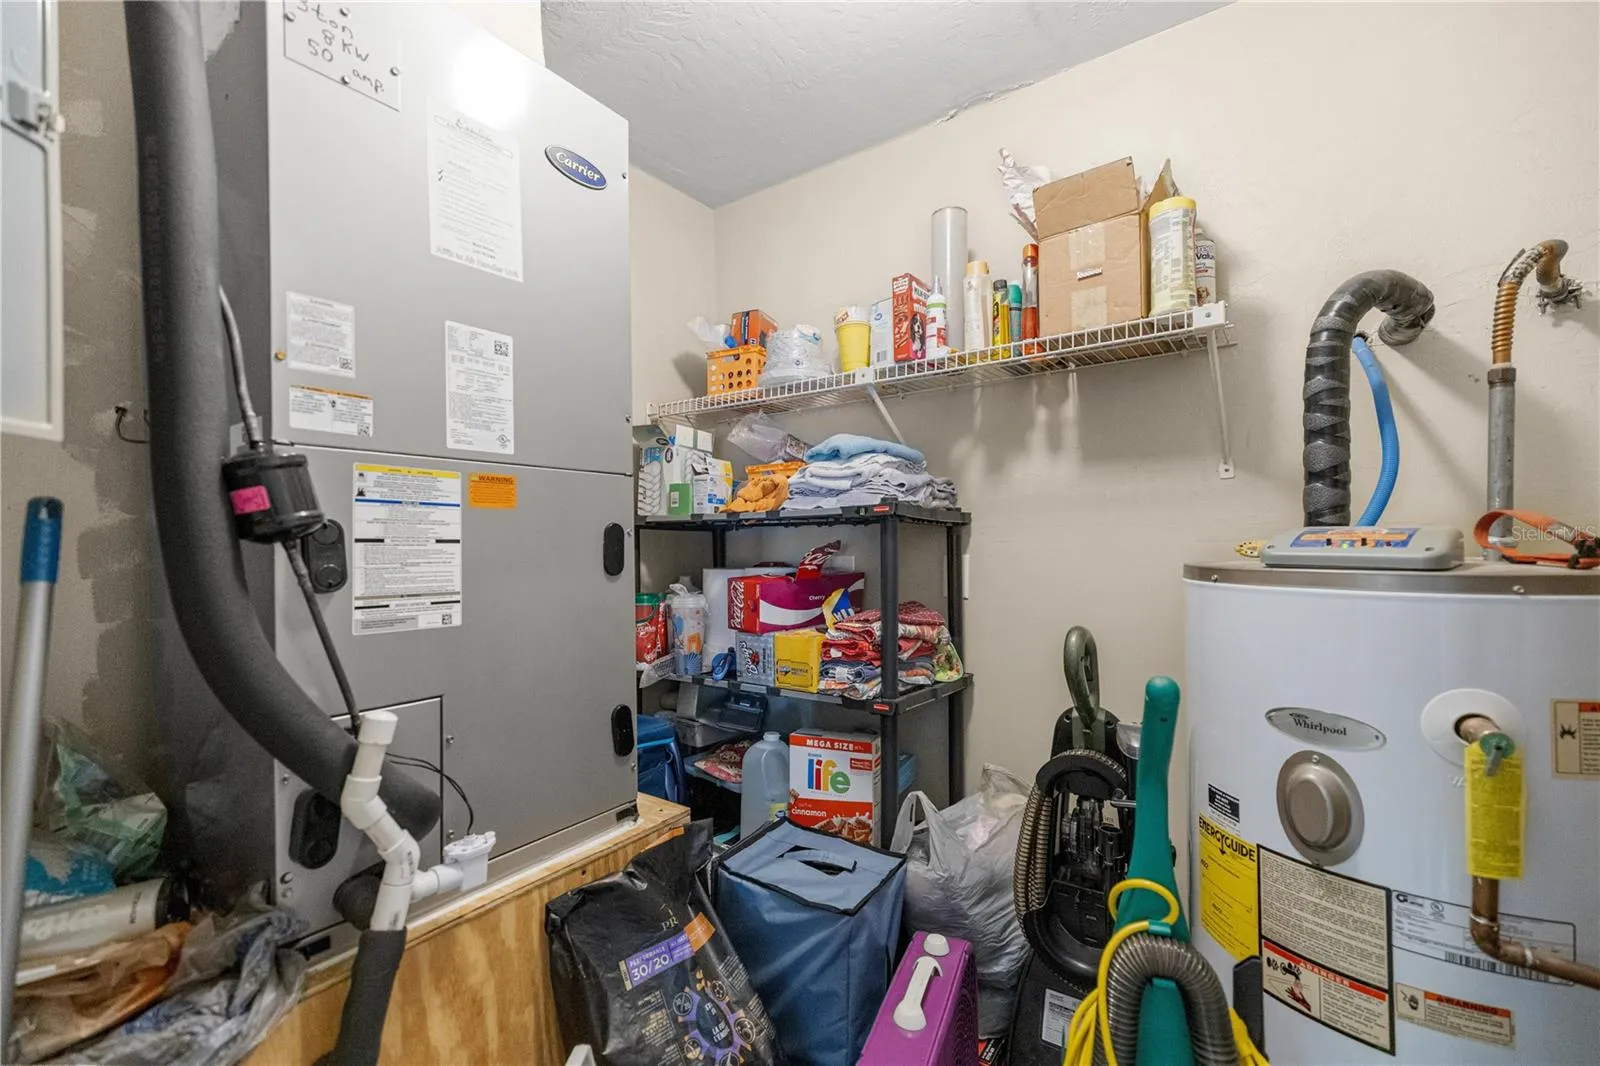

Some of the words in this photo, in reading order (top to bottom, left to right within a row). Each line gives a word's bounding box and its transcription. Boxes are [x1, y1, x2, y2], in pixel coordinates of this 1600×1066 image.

[321, 28, 335, 46] 8
[555, 150, 601, 182] Carrier
[478, 475, 513, 485] WARNING
[1292, 717, 1347, 736] Whirlpool
[806, 739, 832, 749] MEGA
[834, 742, 854, 751] SIZE
[808, 758, 851, 794] life
[791, 807, 827, 817] cinnamon
[631, 954, 670, 981] 30/20
